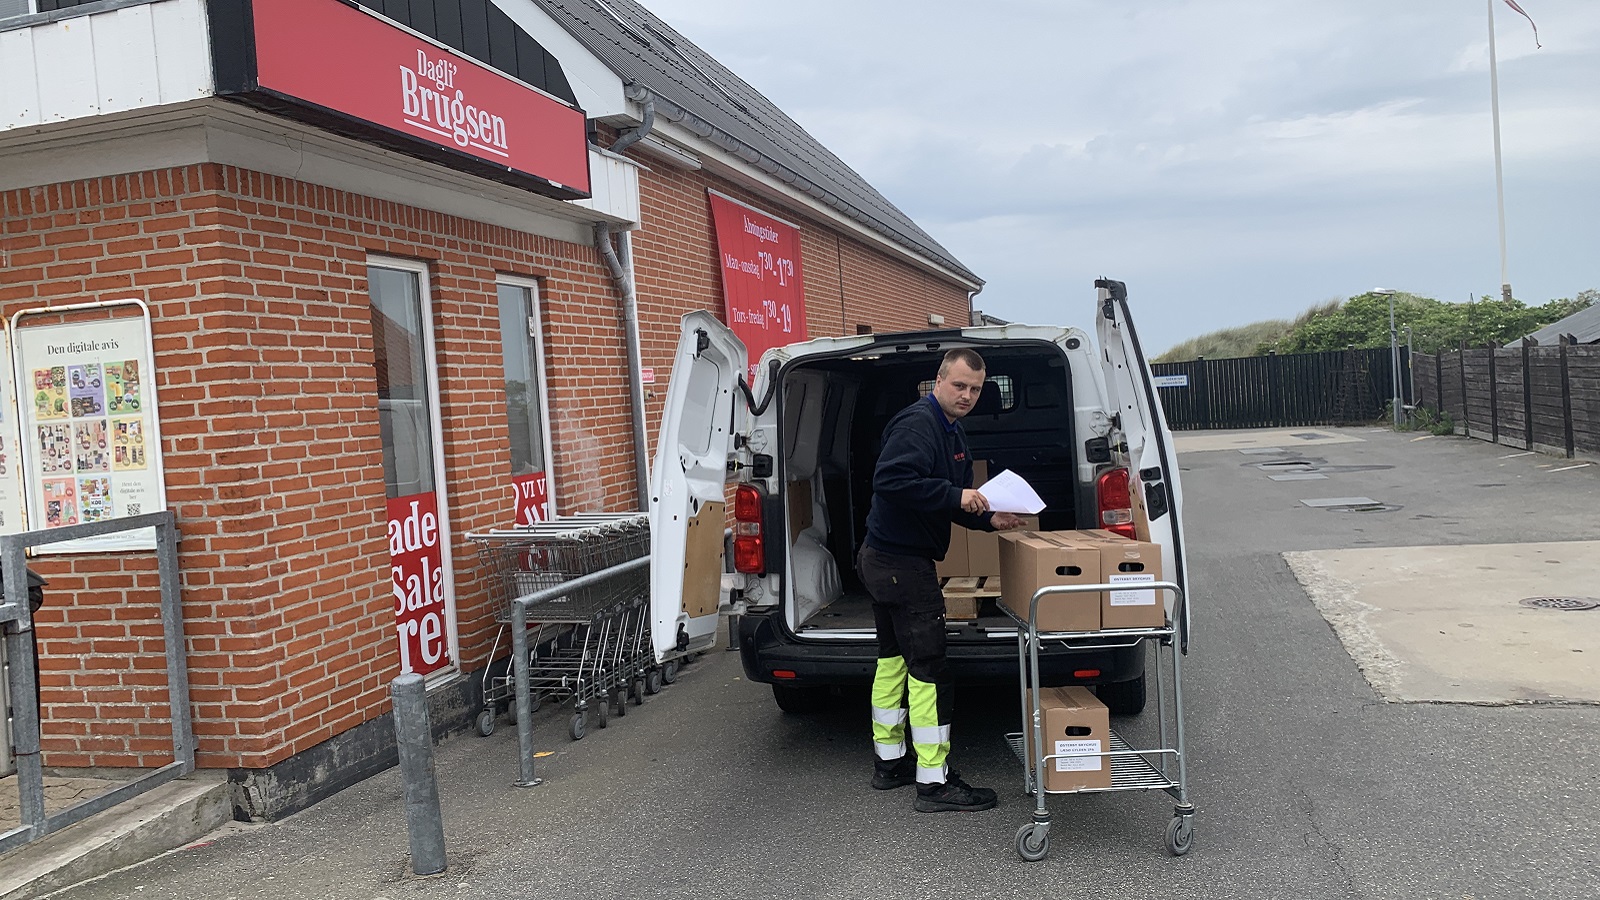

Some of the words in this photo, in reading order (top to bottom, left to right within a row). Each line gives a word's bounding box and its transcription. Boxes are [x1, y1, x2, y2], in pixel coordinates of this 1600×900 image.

[399, 65, 509, 149] Brugsen
[47, 343, 65, 355] Den
[66, 340, 100, 355] digitale
[101, 339, 119, 352] avis
